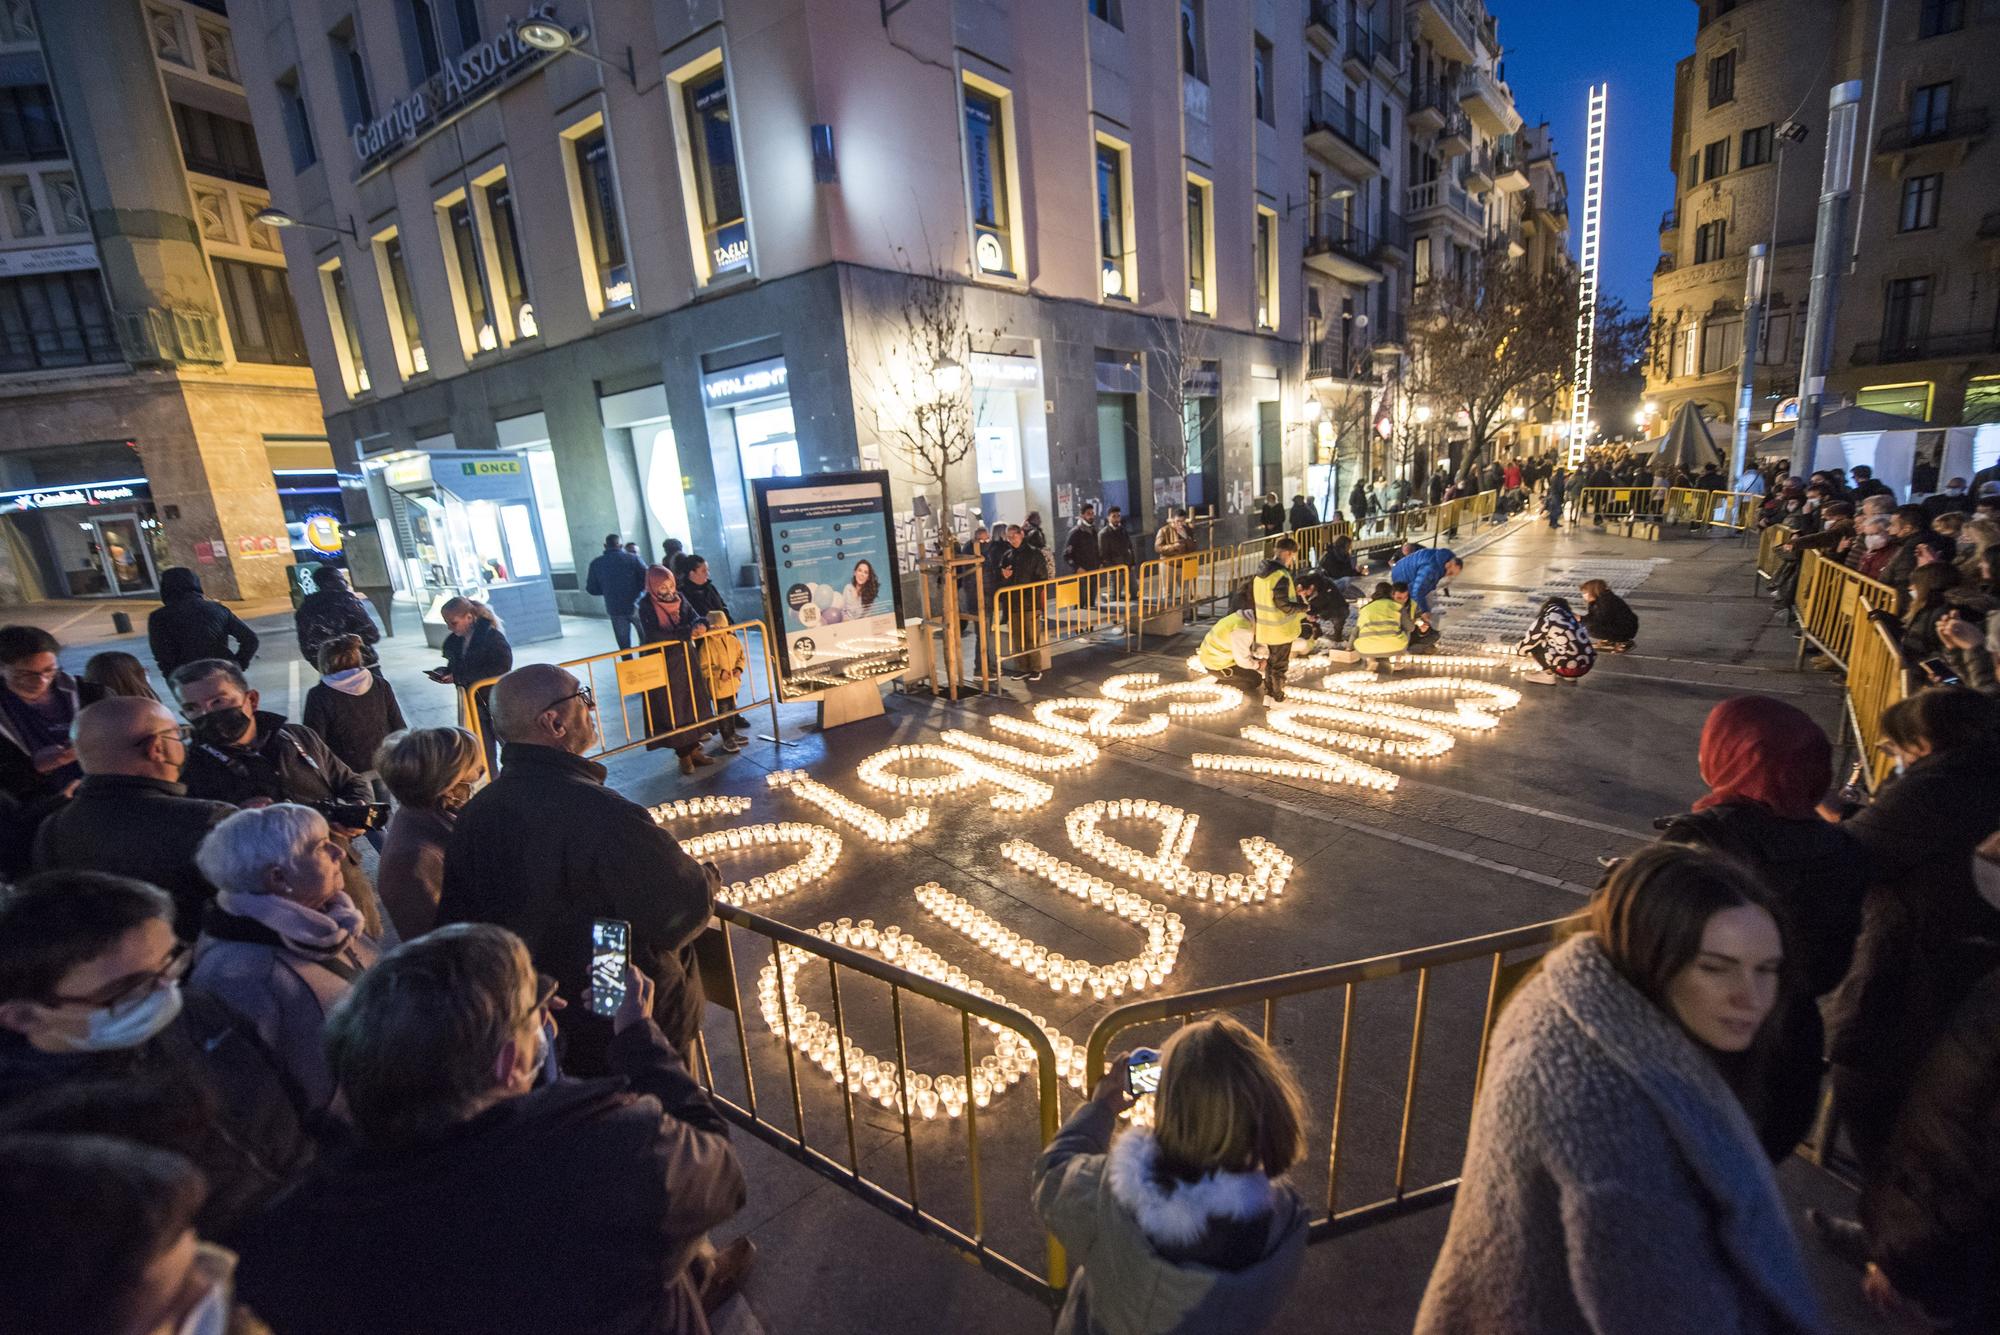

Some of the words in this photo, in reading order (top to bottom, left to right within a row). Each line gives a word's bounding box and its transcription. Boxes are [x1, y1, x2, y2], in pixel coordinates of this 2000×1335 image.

[352, 91, 427, 161] Garriga
[443, 1, 557, 103] Associts
[705, 366, 787, 399] VITALDENT
[479, 461, 518, 473] ONCE
